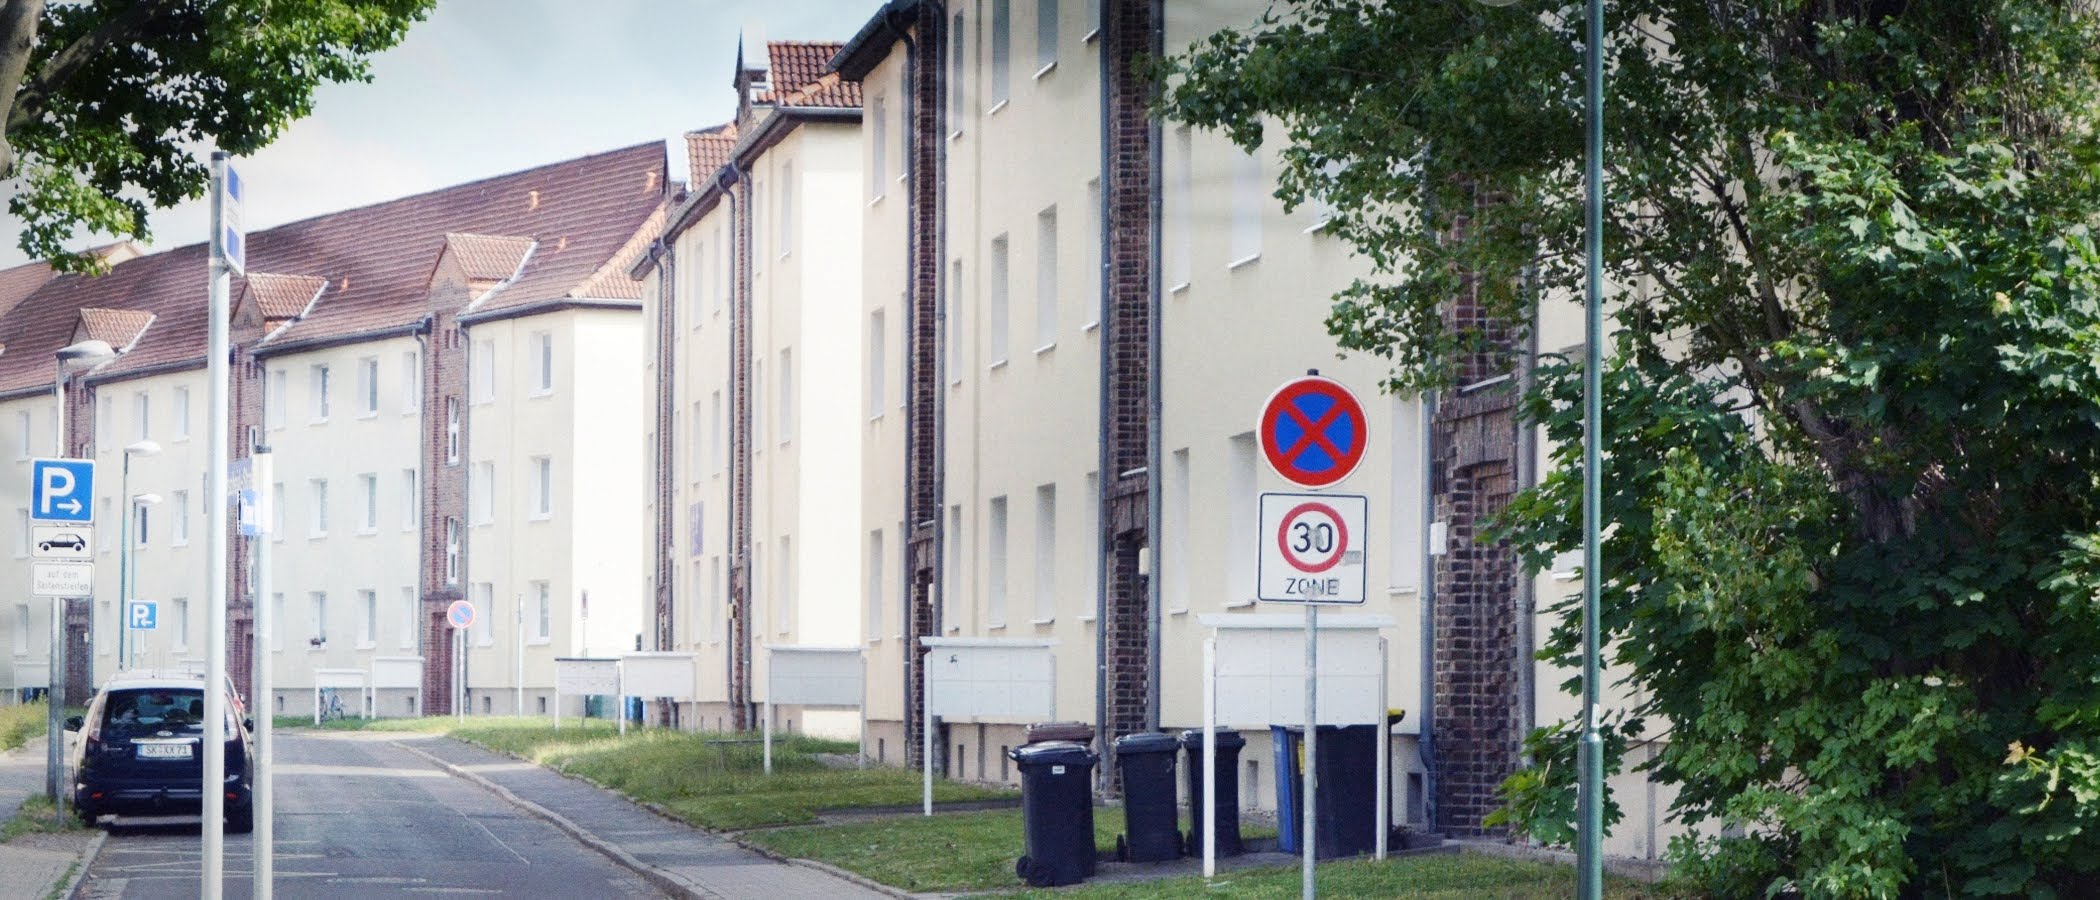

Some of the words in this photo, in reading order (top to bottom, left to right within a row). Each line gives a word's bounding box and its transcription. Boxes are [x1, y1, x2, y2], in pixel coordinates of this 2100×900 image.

[41, 466, 76, 514] P
[1293, 521, 1333, 553] 30
[1286, 578, 1340, 596] ZONE
[132, 604, 150, 627] P
